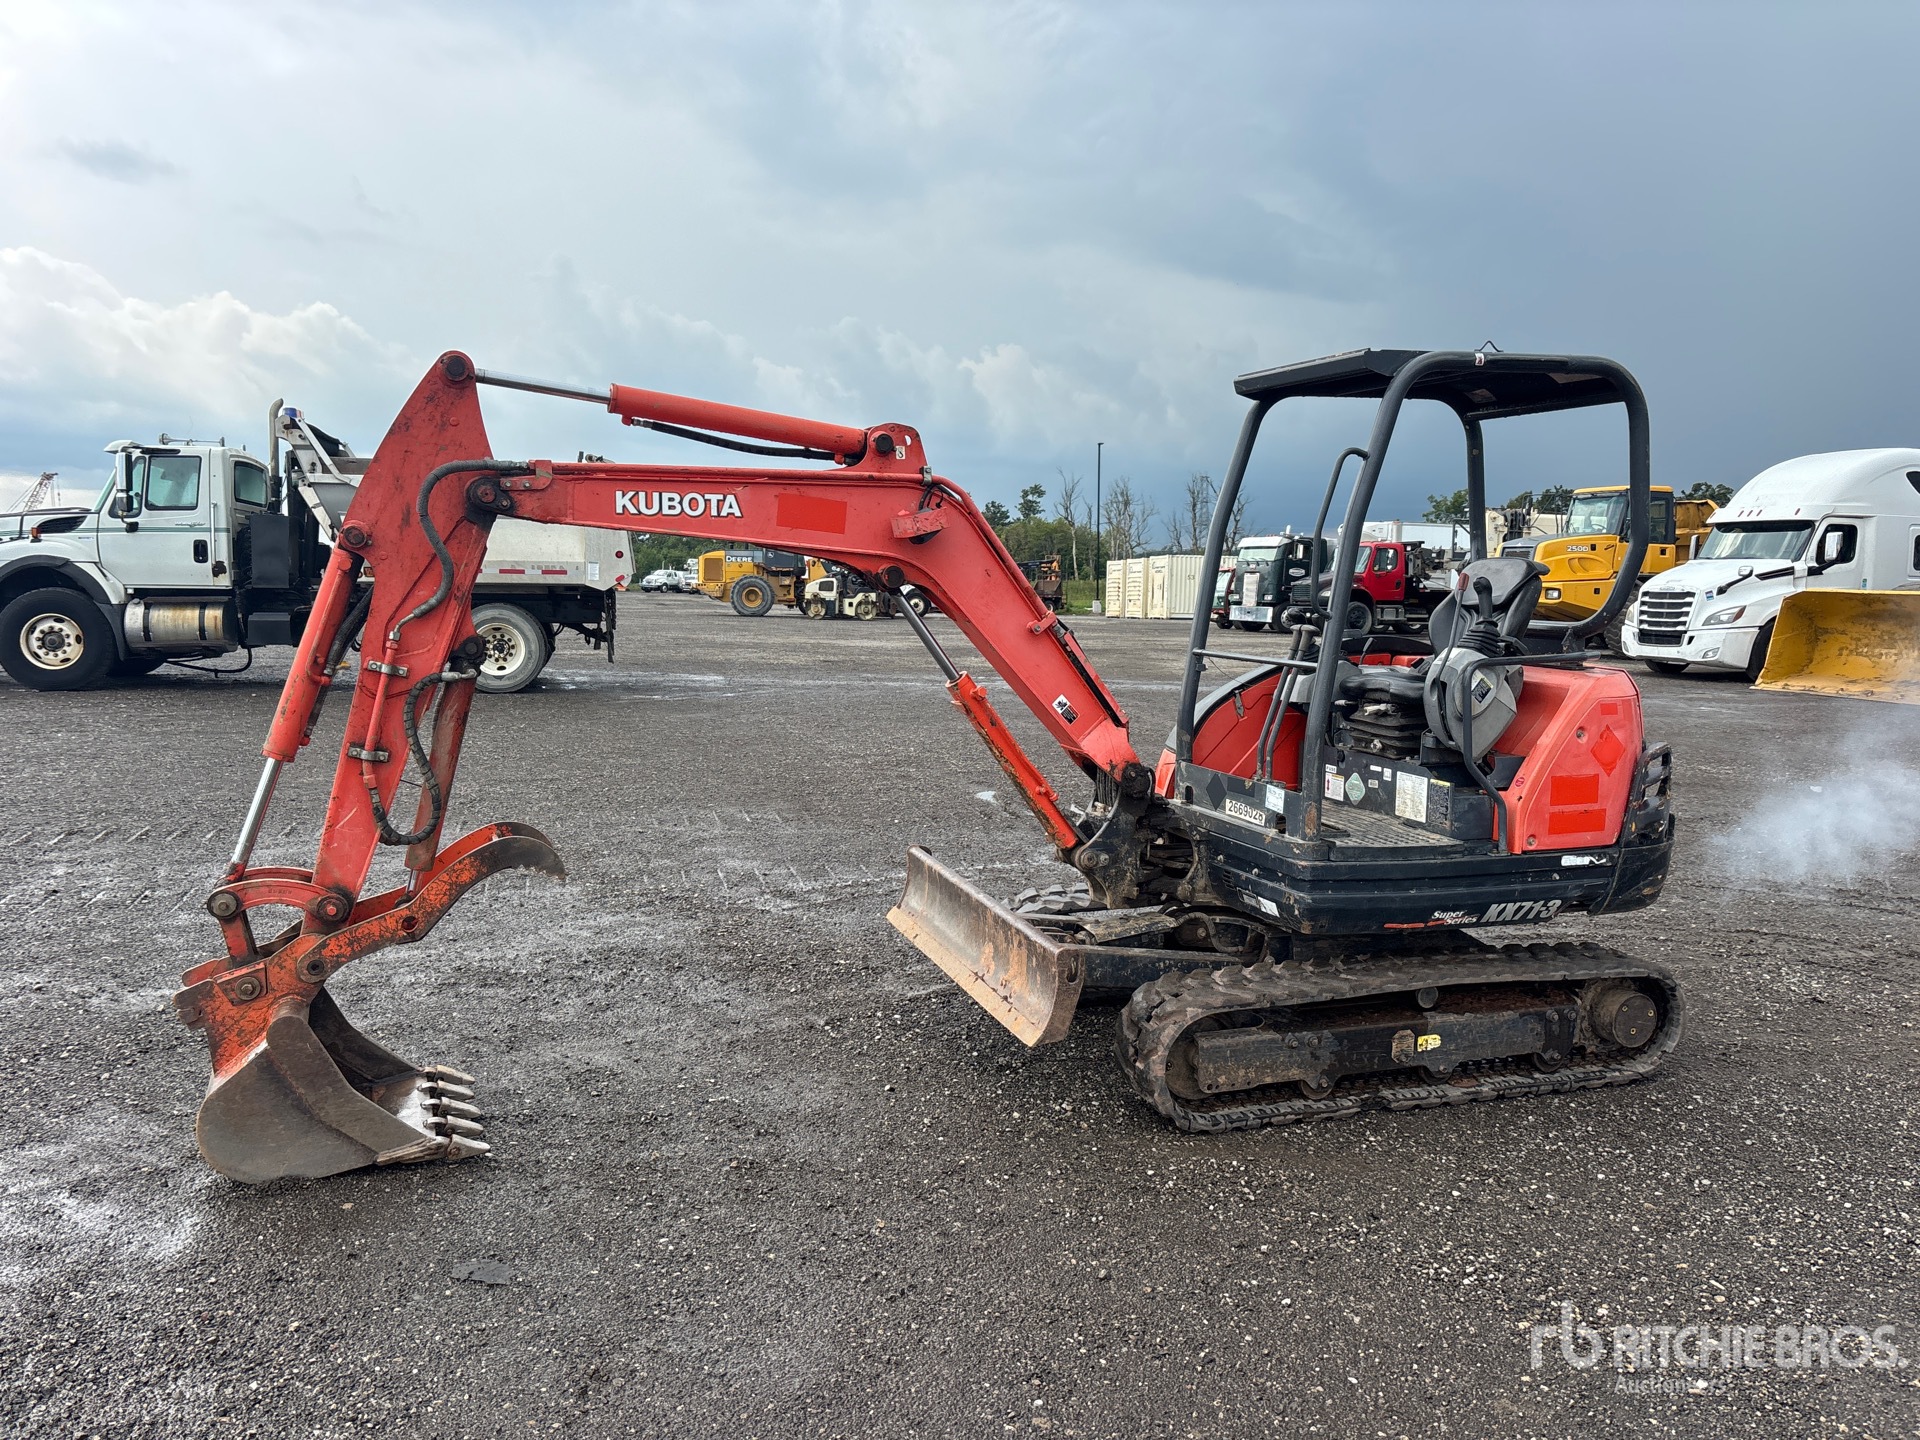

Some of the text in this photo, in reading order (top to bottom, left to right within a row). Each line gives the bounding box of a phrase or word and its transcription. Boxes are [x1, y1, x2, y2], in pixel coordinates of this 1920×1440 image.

[614, 489, 743, 517] KUBOTA
[726, 555, 752, 563] DEERE
[1431, 910, 1467, 919] Super
[1480, 899, 1562, 923] KX71-3
[1444, 916, 1478, 925] Series
